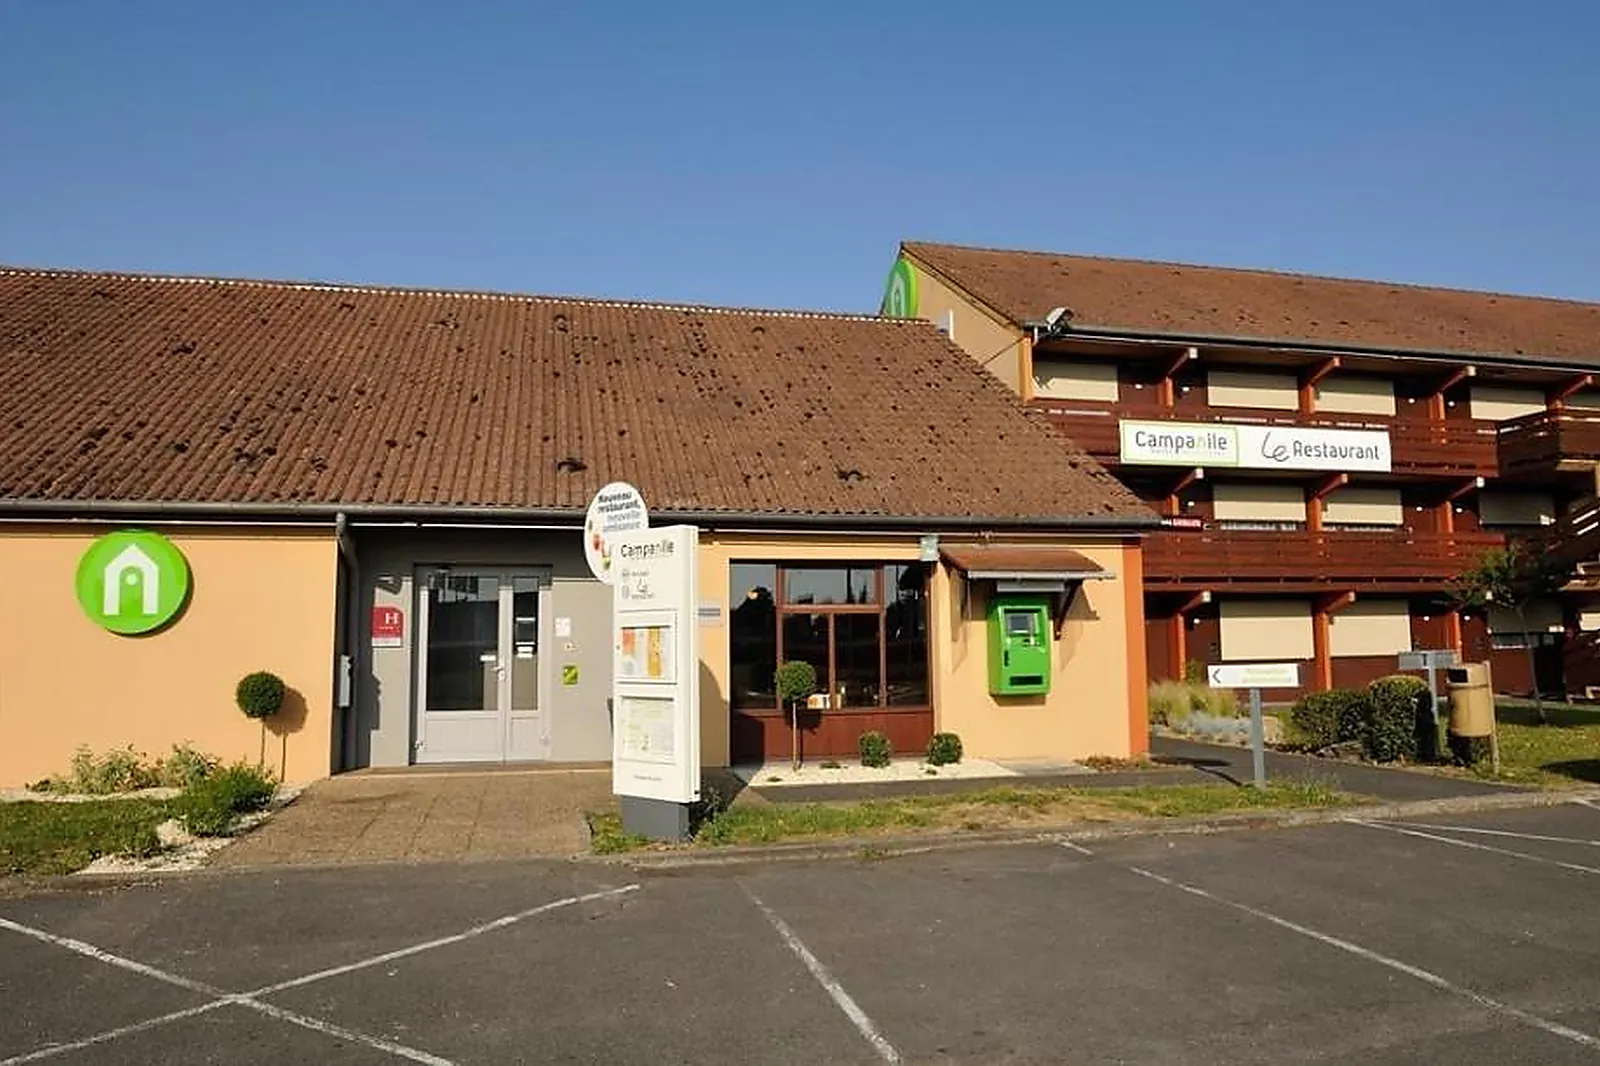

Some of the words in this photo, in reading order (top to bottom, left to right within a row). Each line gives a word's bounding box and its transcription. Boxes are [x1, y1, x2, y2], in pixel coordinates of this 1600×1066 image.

[1135, 431, 1228, 454] Campanile
[1261, 431, 1290, 462] Le
[1293, 440, 1380, 460] Restaurant
[621, 540, 674, 558] Campanile
[385, 612, 399, 625] H
